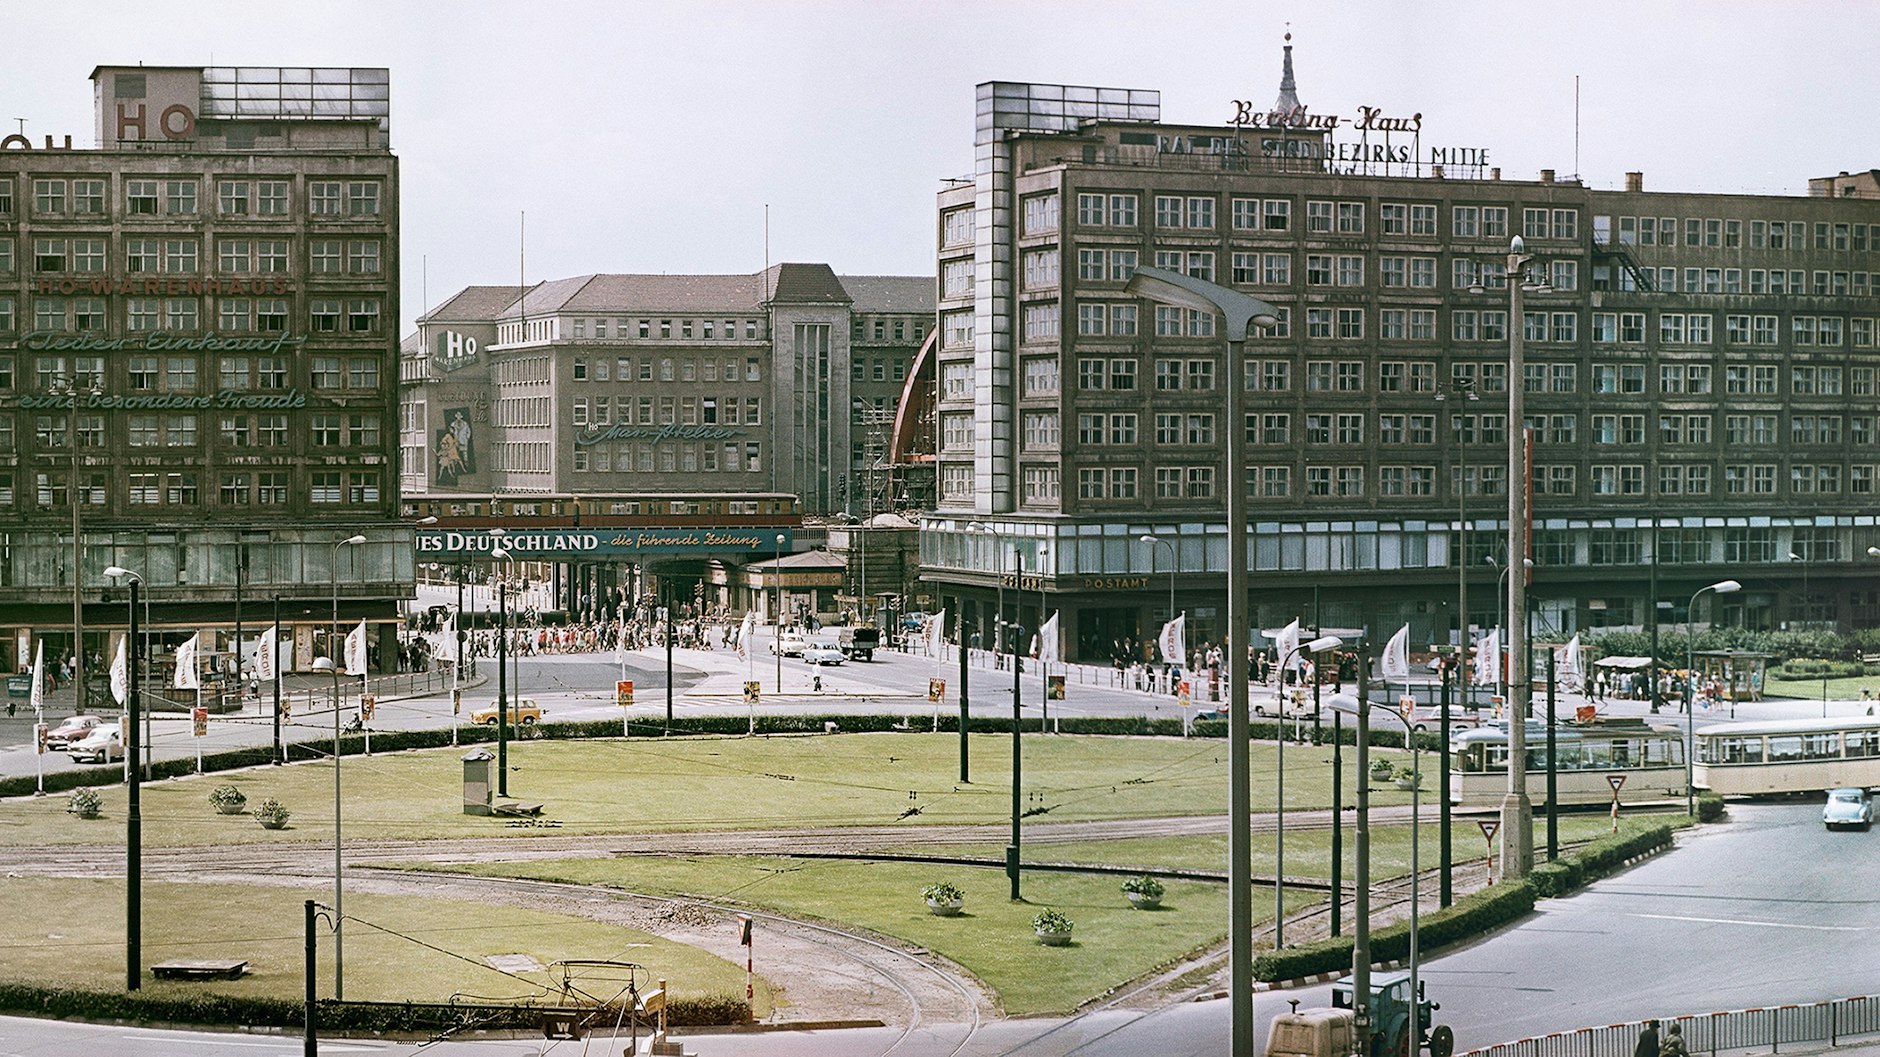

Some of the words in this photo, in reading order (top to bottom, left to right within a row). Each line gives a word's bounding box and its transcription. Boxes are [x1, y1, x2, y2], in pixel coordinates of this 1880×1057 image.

[117, 103, 195, 139] HO
[1156, 134, 1198, 154] RAT
[1210, 136, 1249, 156] DES
[1432, 146, 1490, 165] MITTE
[38, 278, 288, 295] HO-WARENHAUS
[20, 330, 140, 351] Jeder
[144, 330, 308, 354] Einkauf
[20, 394, 78, 409] eine
[86, 392, 211, 409] besondere
[217, 388, 306, 409] Freude
[446, 532, 598, 550] DEUTSCHLAND
[611, 534, 633, 545] die
[636, 534, 699, 549] führende
[703, 532, 762, 549] Zeitung
[1084, 577, 1149, 591] POSTAMT
[556, 1022, 570, 1032] W
